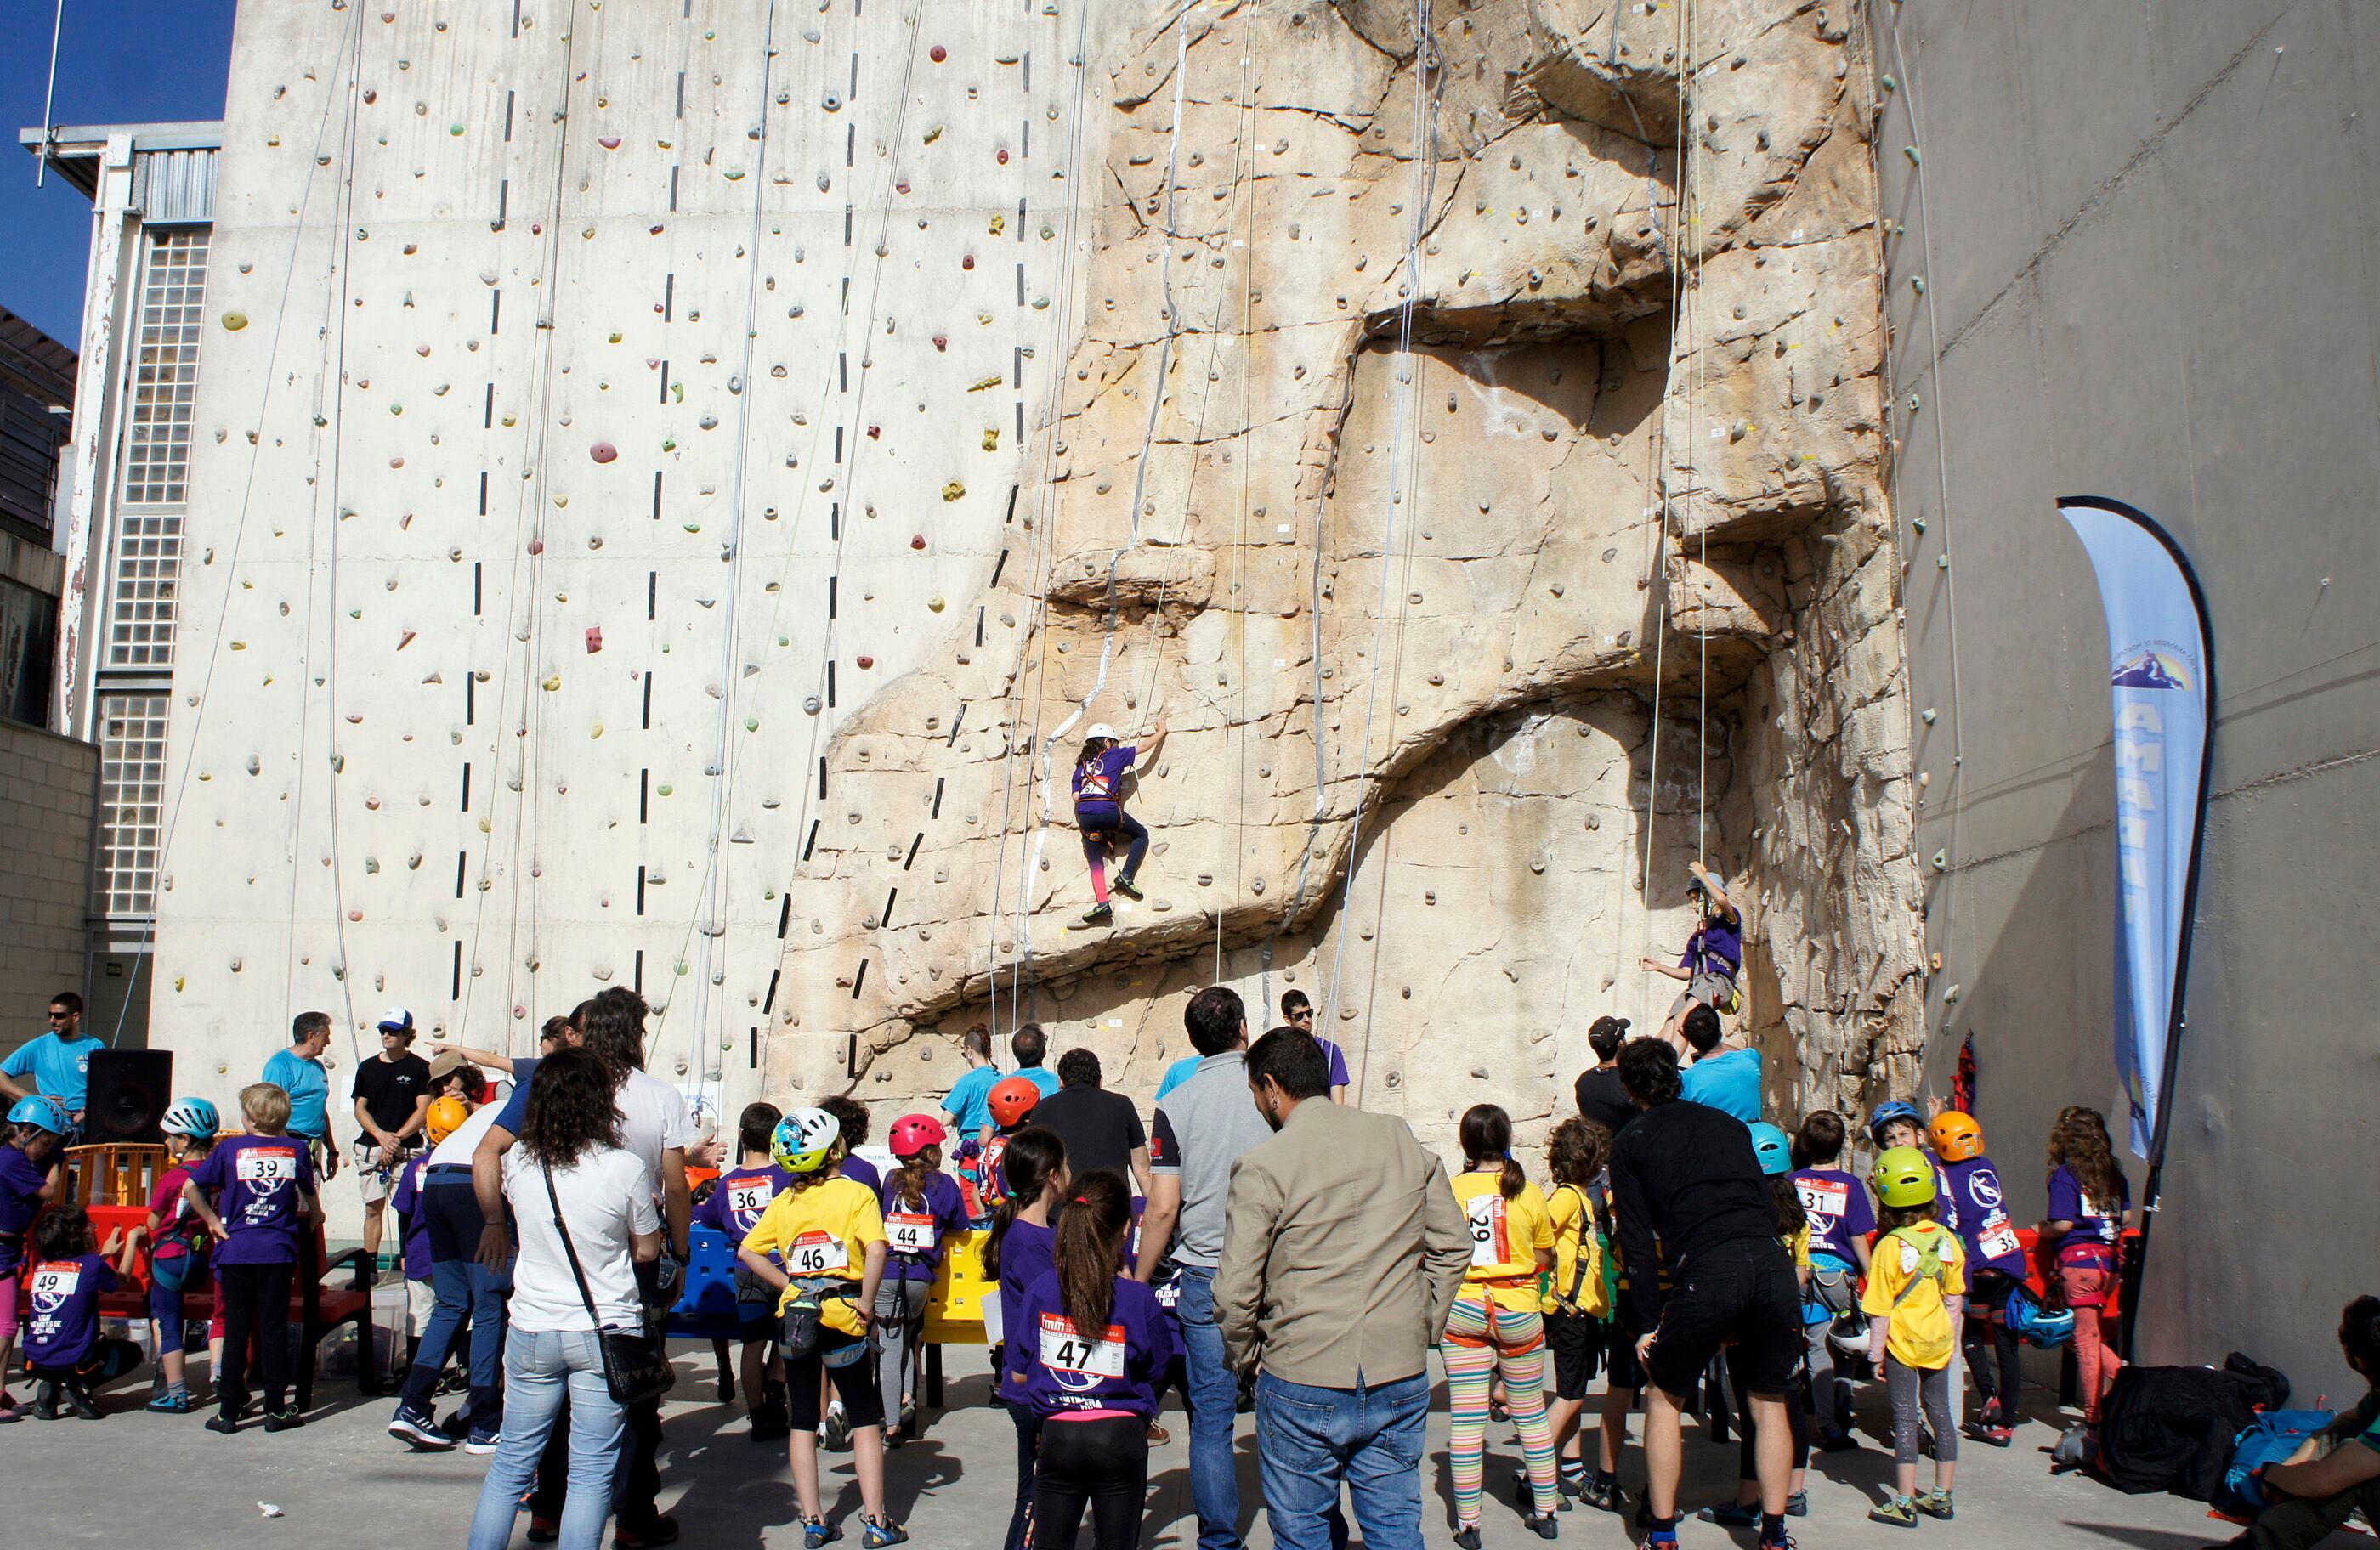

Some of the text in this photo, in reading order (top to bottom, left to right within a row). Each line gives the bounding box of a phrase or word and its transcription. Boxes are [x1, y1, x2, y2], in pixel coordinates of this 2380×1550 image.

[255, 1160, 278, 1178] 39
[737, 1191, 756, 1209] 36
[1804, 1192, 1824, 1211] 31
[898, 1227, 917, 1245] 44
[1470, 1215, 1490, 1242] 29
[802, 1247, 824, 1270] 46
[38, 1275, 58, 1291] 49
[1041, 1314, 1065, 1332] fmm
[1057, 1340, 1093, 1369] 47
